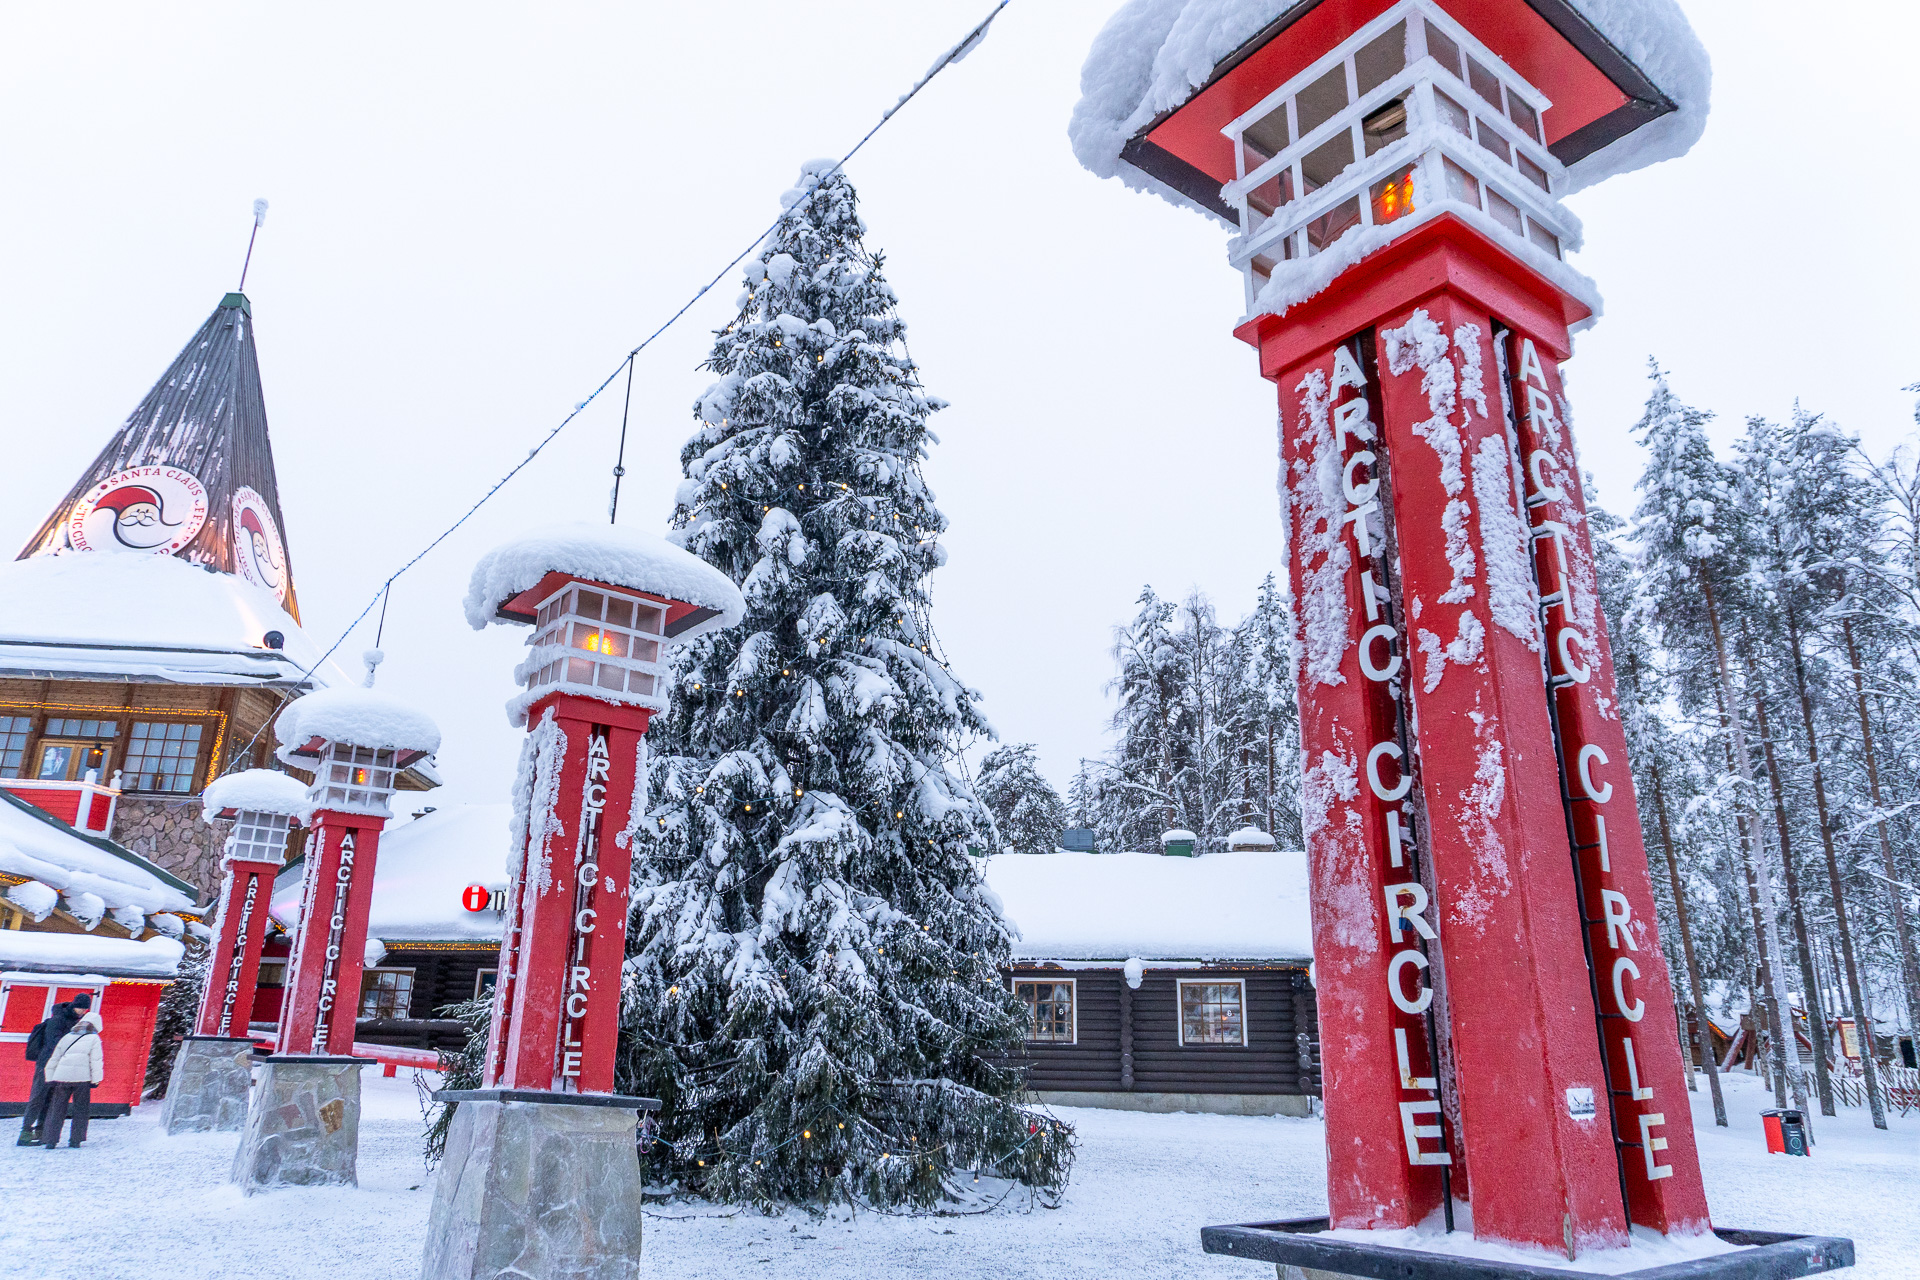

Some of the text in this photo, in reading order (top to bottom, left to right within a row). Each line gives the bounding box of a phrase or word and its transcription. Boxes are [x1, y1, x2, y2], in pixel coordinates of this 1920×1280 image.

[110, 468, 161, 486] SANTA
[166, 469, 202, 496] CLAUS
[1329, 344, 1452, 1166] ARCTIC CIRCLE
[1518, 338, 1672, 1180] ARCTIC CIRCLE
[221, 876, 259, 1028] ARCTIC CIRCLE
[315, 834, 354, 1046] ARCTIC CIRCLE
[562, 735, 610, 1077] ARCTIC CIRCLE
